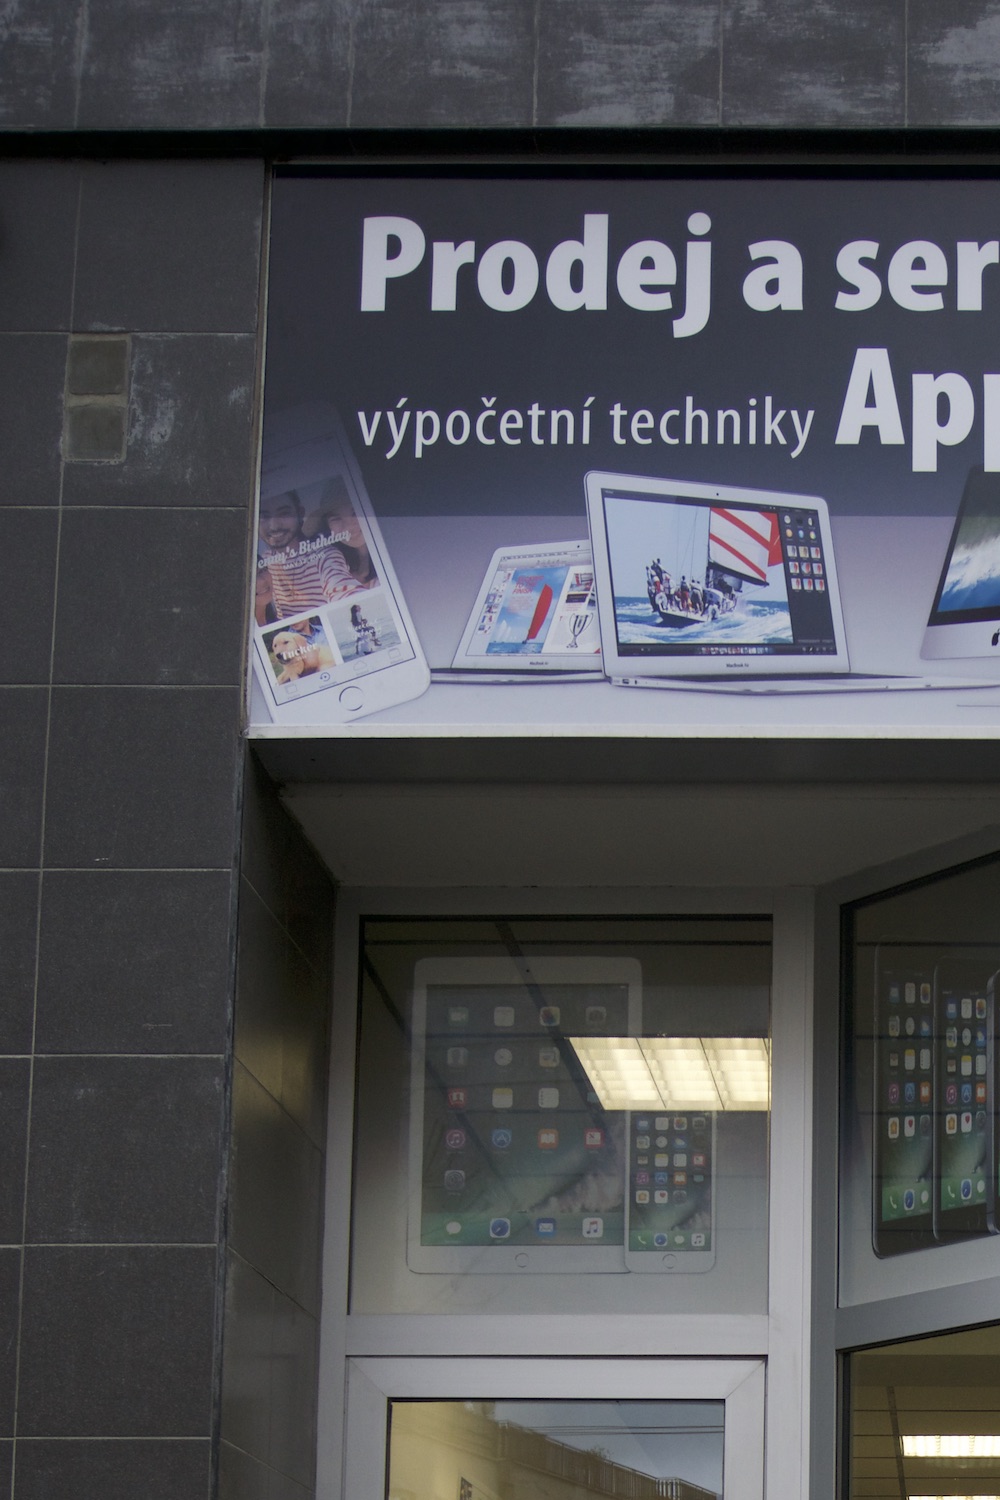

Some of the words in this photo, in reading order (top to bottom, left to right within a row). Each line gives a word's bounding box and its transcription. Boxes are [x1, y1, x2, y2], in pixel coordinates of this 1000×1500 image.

[360, 212, 712, 339] Prodej
[742, 240, 804, 313] a
[357, 396, 596, 460] výpočetní
[609, 395, 815, 459] techniky
[299, 530, 351, 555] Birthday
[280, 642, 318, 660] Tucker
